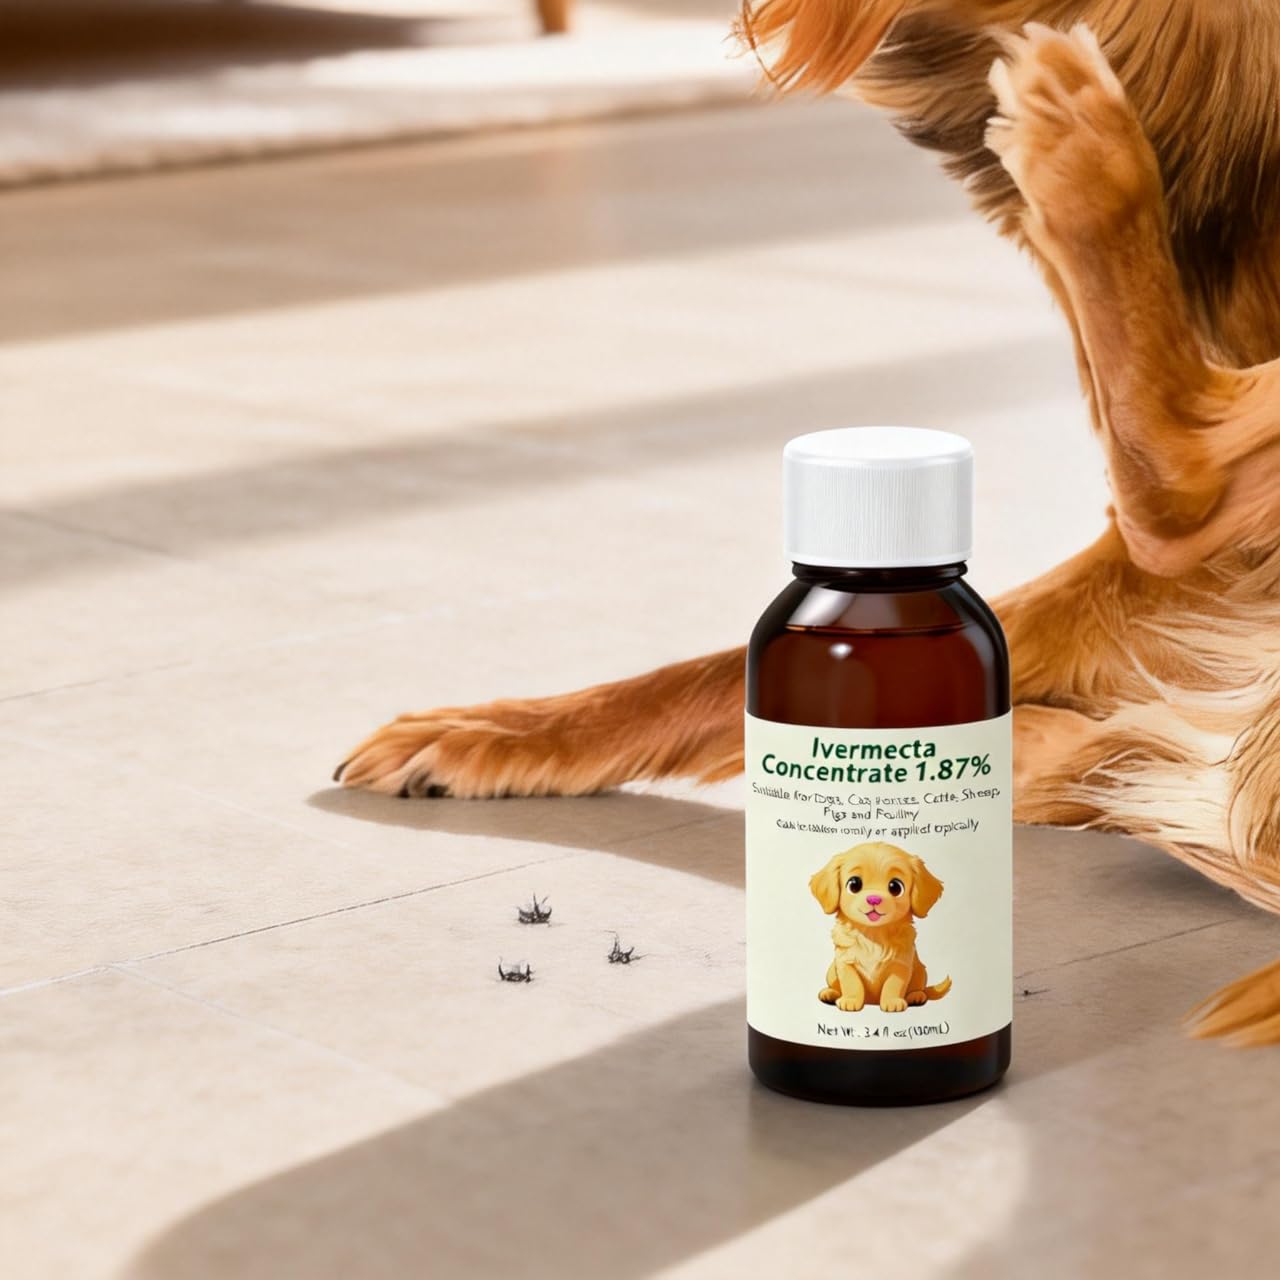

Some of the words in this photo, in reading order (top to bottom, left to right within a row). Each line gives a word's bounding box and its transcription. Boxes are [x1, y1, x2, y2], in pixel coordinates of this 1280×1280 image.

[812, 737, 936, 760] Ivermecta
[762, 753, 908, 783] Concentrate
[915, 753, 992, 782] 1.87%
